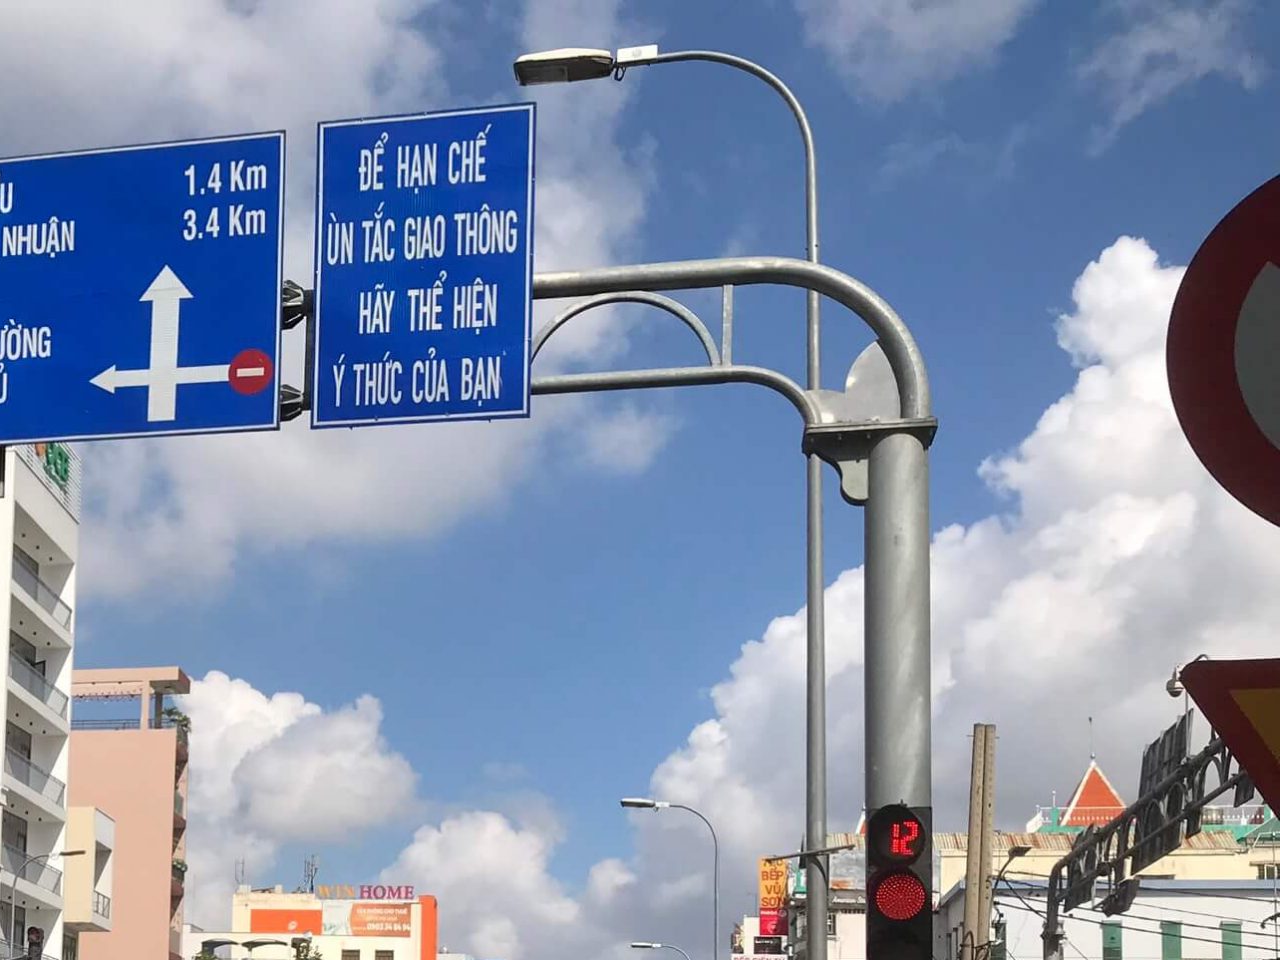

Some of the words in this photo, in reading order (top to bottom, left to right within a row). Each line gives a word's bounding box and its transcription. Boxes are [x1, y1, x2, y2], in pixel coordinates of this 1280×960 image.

[184, 163, 222, 196] 1.4
[230, 159, 267, 192] Km
[359, 132, 389, 191] ĐỂ
[397, 143, 437, 194] HẠN
[448, 123, 492, 184] CHẾ
[2, 216, 75, 258] NHUẬN
[183, 207, 220, 241] 3.4
[229, 204, 266, 237] Km
[327, 212, 354, 265] ÙN
[362, 201, 395, 262] TẮC
[404, 214, 446, 261] GIAO
[454, 203, 518, 256] THÔNG
[359, 283, 395, 334] HÃY
[408, 270, 448, 332] THỂ
[453, 277, 497, 334] HIỆN
[333, 354, 345, 407] Ý
[353, 351, 402, 406] THỨC
[412, 347, 449, 403] CỦA
[461, 356, 500, 407] BẠN
[892, 820, 919, 856] 12
[360, 885, 414, 900] HOME
